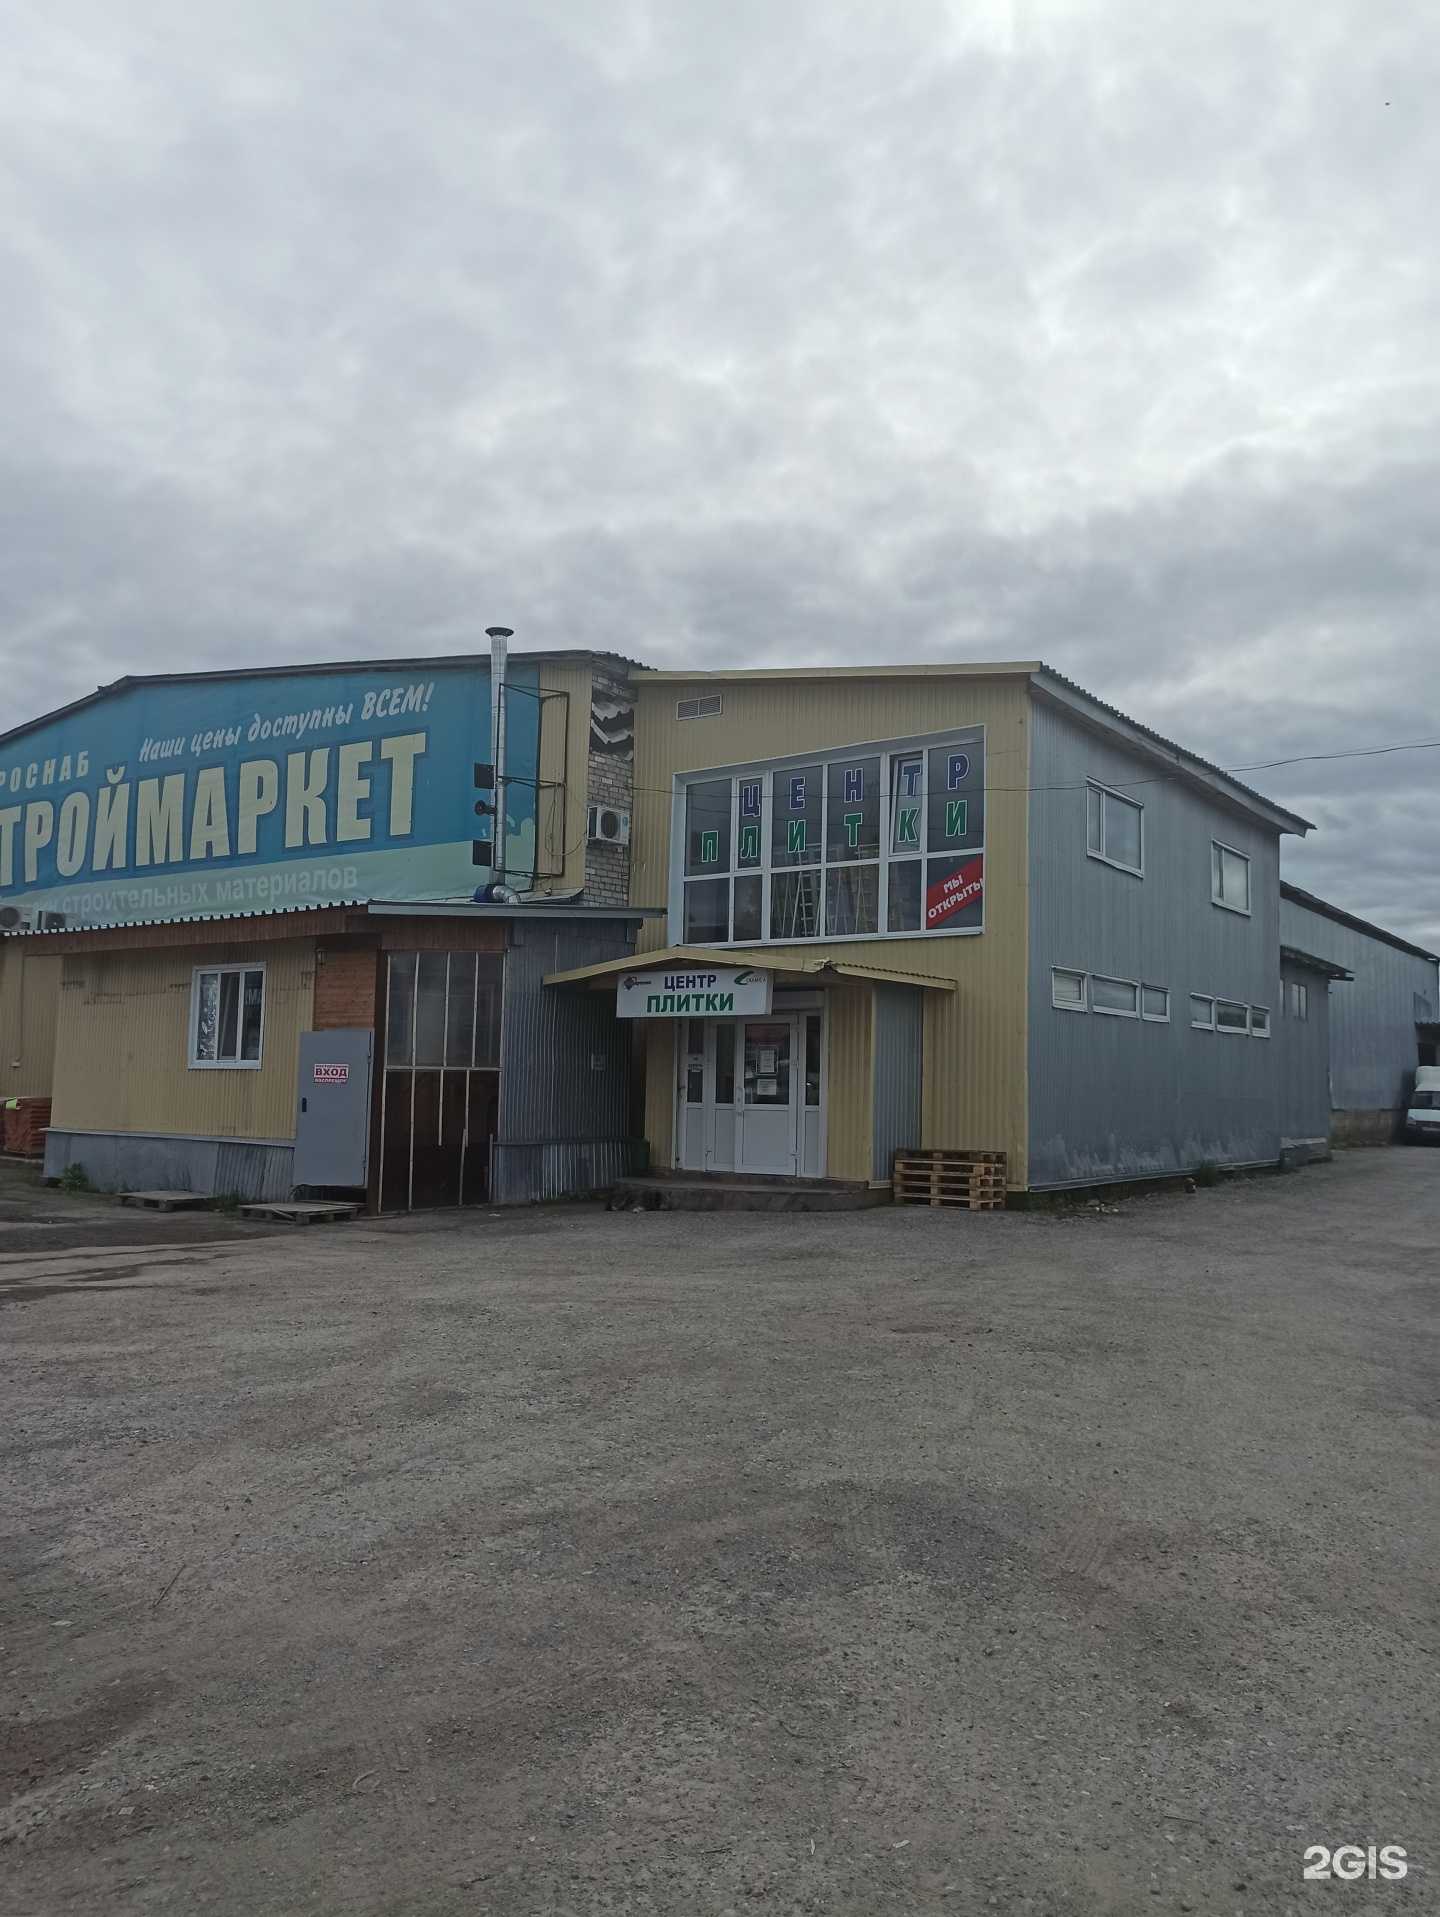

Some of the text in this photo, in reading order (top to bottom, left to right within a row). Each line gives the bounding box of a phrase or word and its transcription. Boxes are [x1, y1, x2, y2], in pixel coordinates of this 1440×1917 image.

[139, 681, 435, 763] Наши цены доступны ВСЕМ!
[0, 732, 427, 887] ТРОЙМАРКЕТ
[743, 753, 970, 817] ЦЕНТР
[701, 800, 968, 863] ПЛИТКИ
[63, 879, 209, 916] строительных
[216, 866, 358, 904] материалов
[943, 874, 964, 894] МЫ
[646, 993, 734, 1013] ПЛИТКИ
[664, 973, 718, 991] ЦЕНТР
[315, 1068, 347, 1077] ВХОД
